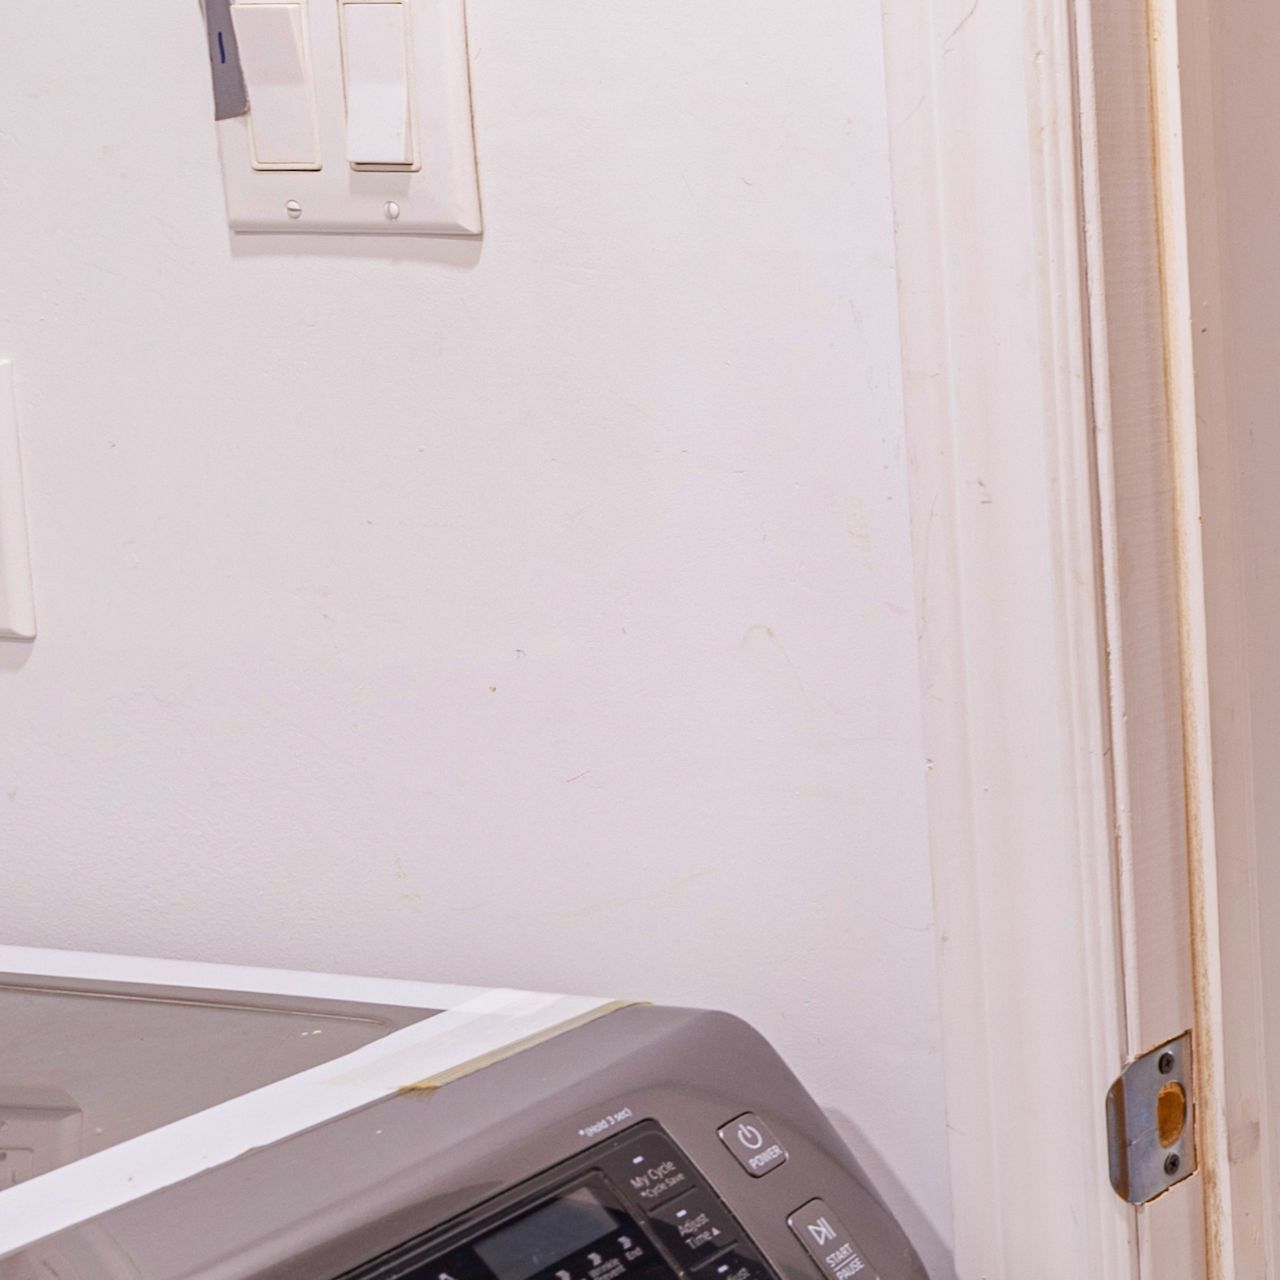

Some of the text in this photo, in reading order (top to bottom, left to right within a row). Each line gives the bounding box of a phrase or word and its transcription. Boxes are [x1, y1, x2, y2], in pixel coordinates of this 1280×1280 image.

[607, 1113, 616, 1125] 3
[748, 1145, 784, 1171] POWER
[630, 1159, 677, 1191] My Cycle
[664, 1171, 685, 1188] Save
[677, 1212, 710, 1238] Adjust
[685, 1229, 712, 1250] Time
[624, 1246, 644, 1262] End
[825, 1242, 854, 1269] START
